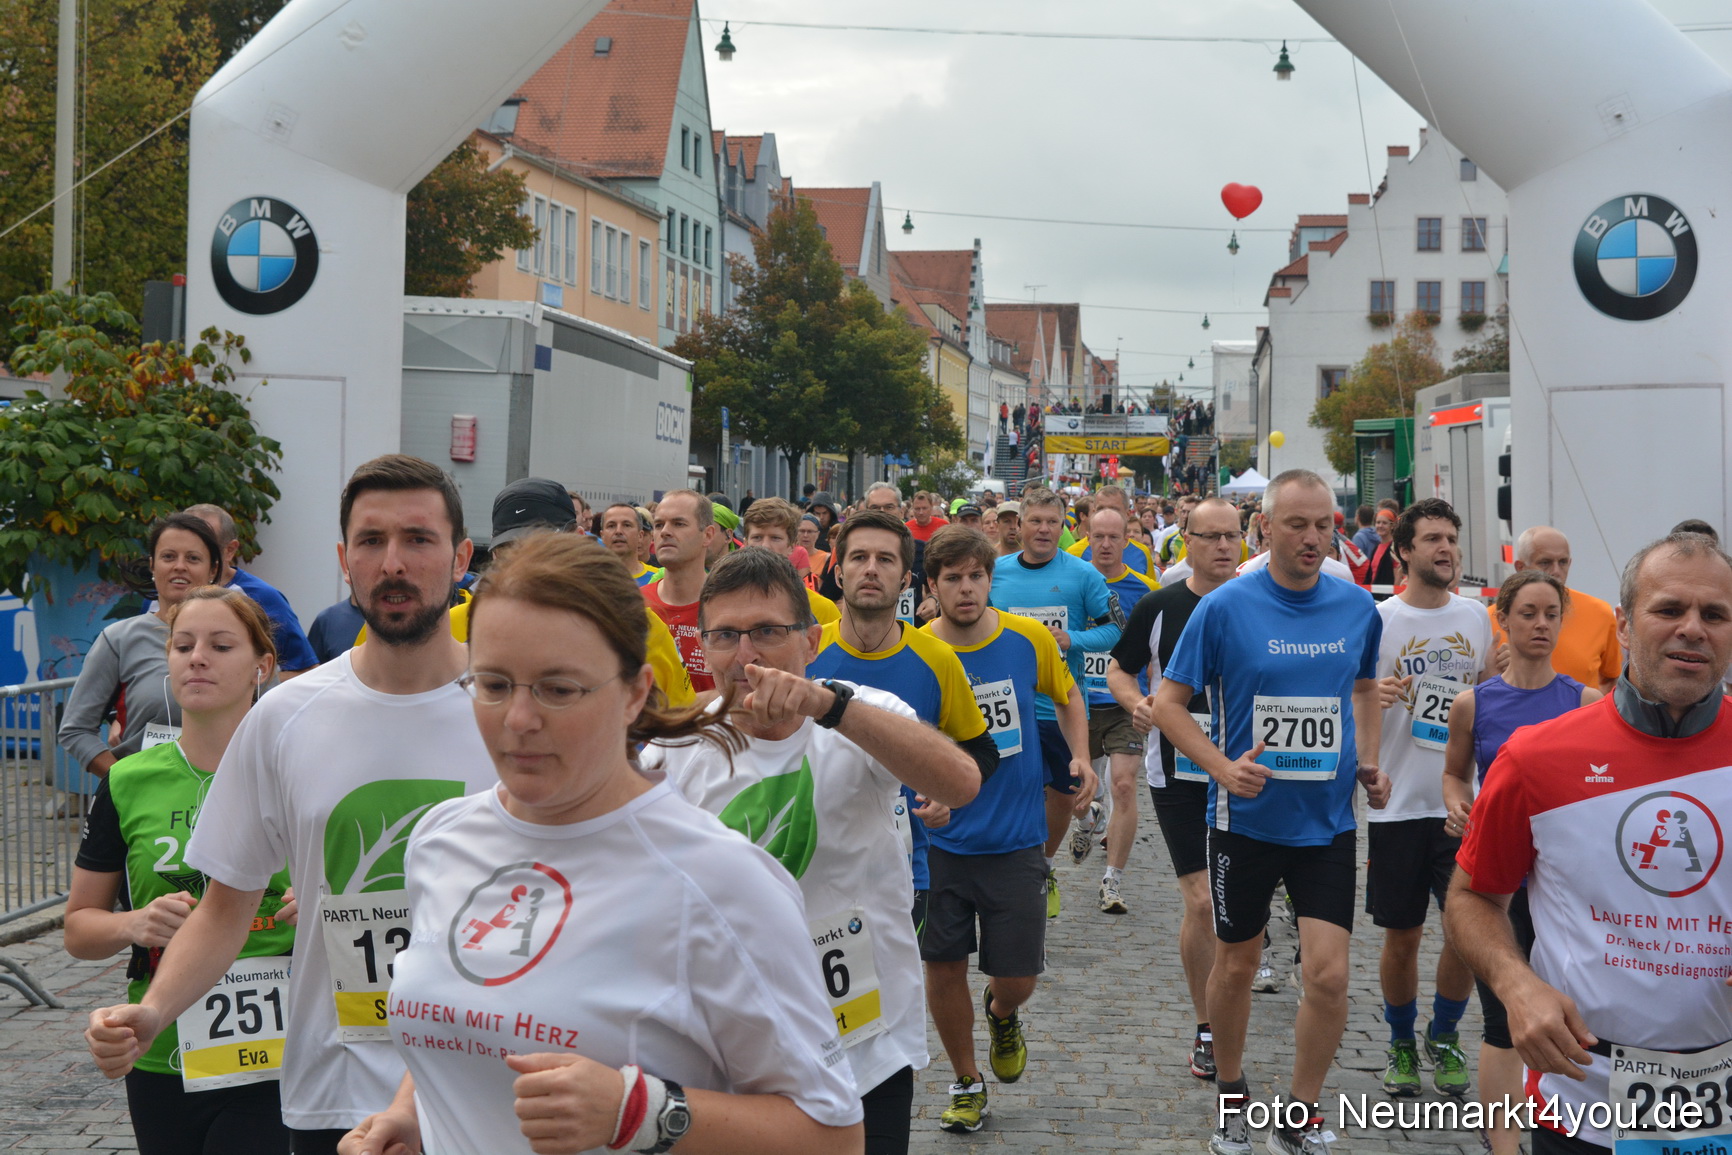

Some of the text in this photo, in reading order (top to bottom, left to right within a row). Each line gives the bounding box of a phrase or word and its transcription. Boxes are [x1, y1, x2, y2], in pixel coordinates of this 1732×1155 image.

[219, 199, 311, 239] BMW
[1583, 197, 1689, 239] BMW
[656, 401, 685, 445] BOCK
[1085, 440, 1128, 450] START
[1085, 657, 1112, 675] 20
[1422, 681, 1446, 693] PARTL
[978, 699, 1012, 731] 35
[1255, 704, 1328, 713] PARTL Neumarkt
[1422, 694, 1454, 723] 25
[1262, 717, 1335, 748] 2709
[1275, 755, 1322, 769] Günther
[1585, 774, 1614, 783] erima
[170, 805, 197, 830] FÜ
[153, 836, 186, 873] 2
[249, 916, 275, 931] BI
[323, 908, 369, 922] PARTL
[1590, 904, 1732, 934] LAUFEN MIT HE
[813, 927, 844, 946] arkt
[1606, 933, 1732, 956] Dr. Heck / Dr. Rösch
[353, 927, 411, 983] 13
[225, 969, 284, 984] Neumarkt
[205, 987, 284, 1040] 251
[374, 999, 387, 1020] S
[389, 992, 579, 1048] LAUFEN MIT HERZ
[402, 1032, 421, 1047] Dr.
[424, 1034, 464, 1052] Heck
[476, 1042, 498, 1058] Dr.
[238, 1049, 269, 1066] Eva
[1614, 1057, 1732, 1079] PARTL Neumarkt
